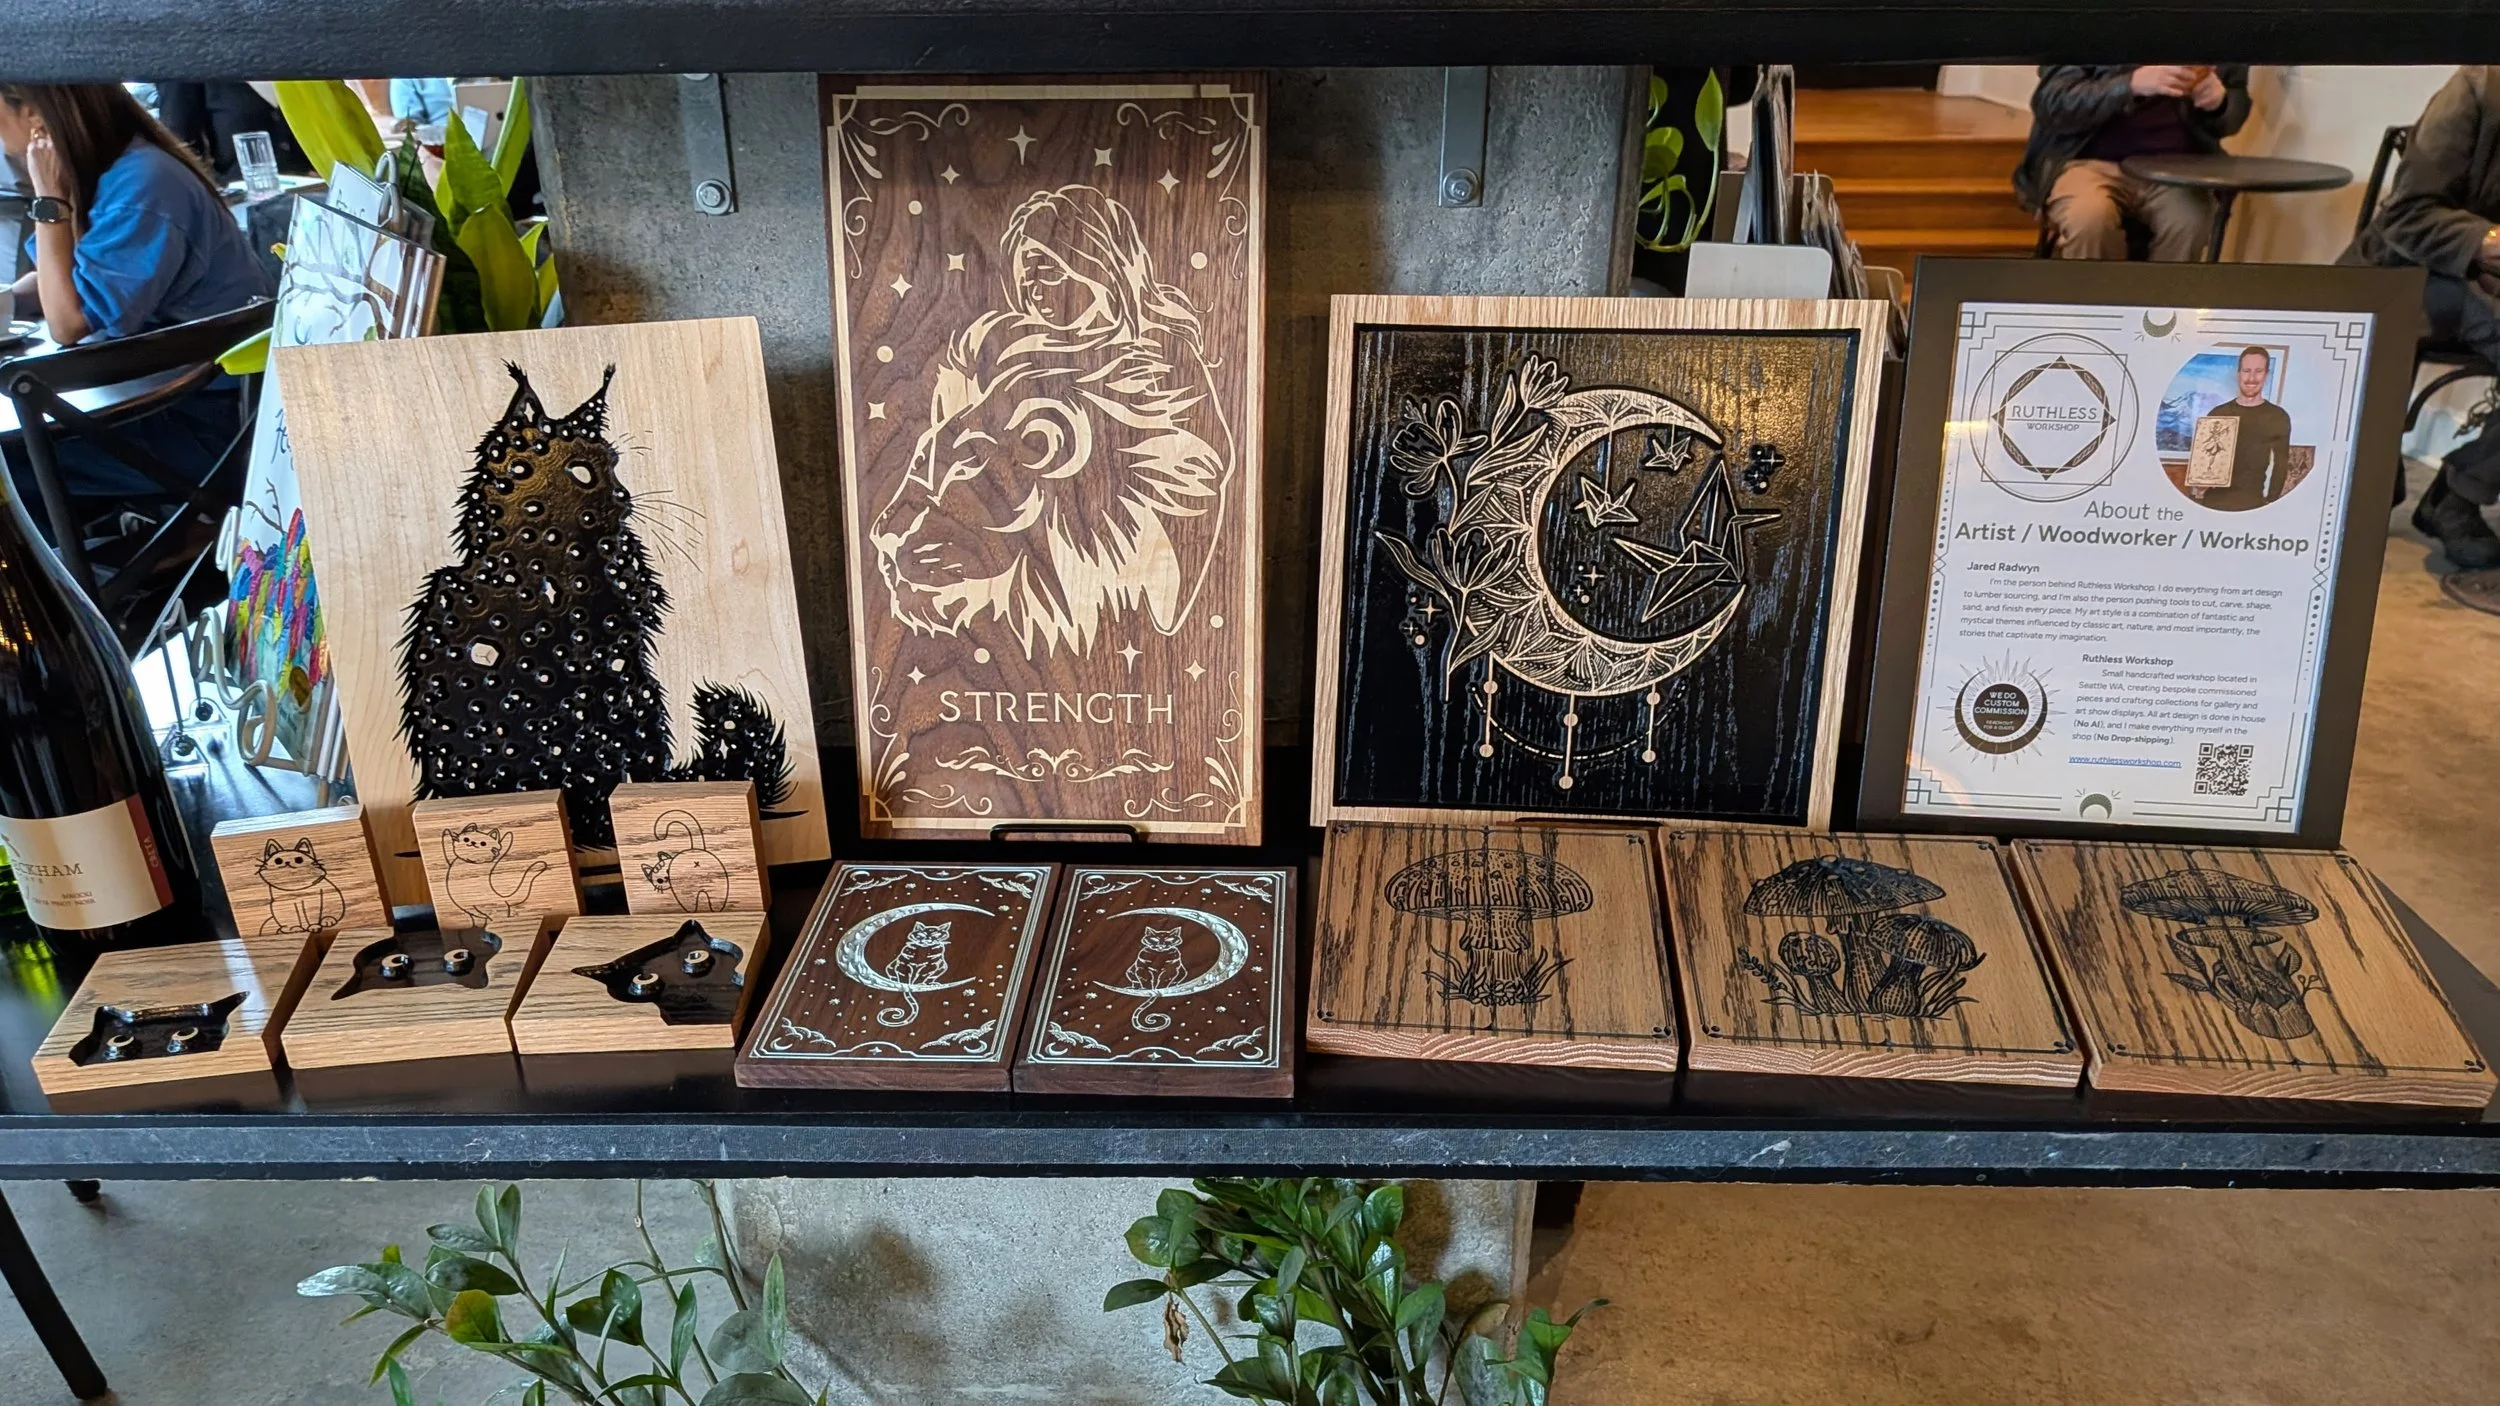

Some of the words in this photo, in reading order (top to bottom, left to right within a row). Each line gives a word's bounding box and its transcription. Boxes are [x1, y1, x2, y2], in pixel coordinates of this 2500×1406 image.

[2012, 405, 2097, 420] RUTHLESS
[2027, 423, 2080, 431] WORKSHOP
[2083, 500, 2150, 520] About
[2157, 507, 2184, 521] the
[1955, 522, 2016, 541] Artist
[2021, 523, 2033, 543] /
[2038, 524, 2177, 547] Woodworker
[2182, 529, 2194, 549] /
[2200, 531, 2309, 556] Workshop
[1967, 562, 1995, 571] Jared
[1999, 562, 2040, 574] Radwyn
[2018, 580, 2046, 589] person
[2048, 580, 2075, 588] behind
[2078, 581, 2112, 590] Ruthless
[2175, 586, 2219, 596] everything
[2221, 587, 2240, 595] from
[2242, 588, 2253, 596] art
[2255, 589, 2283, 598] design
[1974, 591, 2001, 599] lumber
[2091, 595, 2105, 603] the
[2106, 596, 2133, 605] person
[2135, 597, 2167, 607] pushing
[2170, 598, 2189, 606] tools
[2192, 599, 2200, 607] to
[1985, 604, 1999, 612] and
[2002, 605, 2023, 613] finish
[2025, 607, 2047, 615] every
[2075, 607, 2087, 616] My
[2089, 608, 2101, 616] art
[2103, 609, 2121, 617] style
[2139, 610, 2189, 619] combination
[2191, 612, 2200, 620] of
[2201, 612, 2237, 621] fantastic
[2239, 614, 2254, 622] and
[1961, 617, 1993, 626] mystical
[1995, 618, 2025, 626] themes
[2027, 619, 2069, 628] influenced
[2071, 620, 2081, 629] by
[2083, 621, 2109, 629] classic
[2156, 624, 2171, 632] and
[2173, 625, 2194, 633] most
[2247, 627, 2260, 636] the
[1959, 629, 1985, 638] stories
[1987, 630, 2004, 638] that
[2006, 632, 2043, 641] captivate
[2045, 633, 2058, 641] my
[2082, 654, 2123, 664] Ruthless
[2125, 656, 2173, 667] Workshop
[2102, 669, 2124, 677] Small
[2125, 670, 2174, 680] handcrafted
[2176, 673, 2215, 683] workshop
[2217, 675, 2248, 683] located
[2079, 681, 2107, 689] Seattle
[2127, 685, 2160, 694] creating
[2162, 686, 2196, 694] bespoke
[2198, 688, 2256, 696] commissioned
[938, 690, 1173, 725] STRENGTH
[2077, 695, 2103, 703] pieces
[2122, 697, 2153, 706] crafting
[2155, 698, 2198, 707] collections
[2214, 701, 2241, 710] gallery
[1975, 707, 2027, 715] COMMISSION
[2075, 707, 2086, 715] art
[2088, 708, 2110, 716] show
[2147, 710, 2158, 718] All
[2172, 712, 2199, 721] design
[2209, 713, 2230, 721] done
[2241, 715, 2266, 723] house
[2074, 719, 2089, 728] (No
[2152, 725, 2194, 734] everything
[2196, 726, 2223, 735] myself
[2234, 727, 2247, 735] the
[2072, 732, 2091, 741] shop
[2093, 733, 2109, 742] (No
[2069, 755, 2182, 769] www.ruthlessworkshop.com
